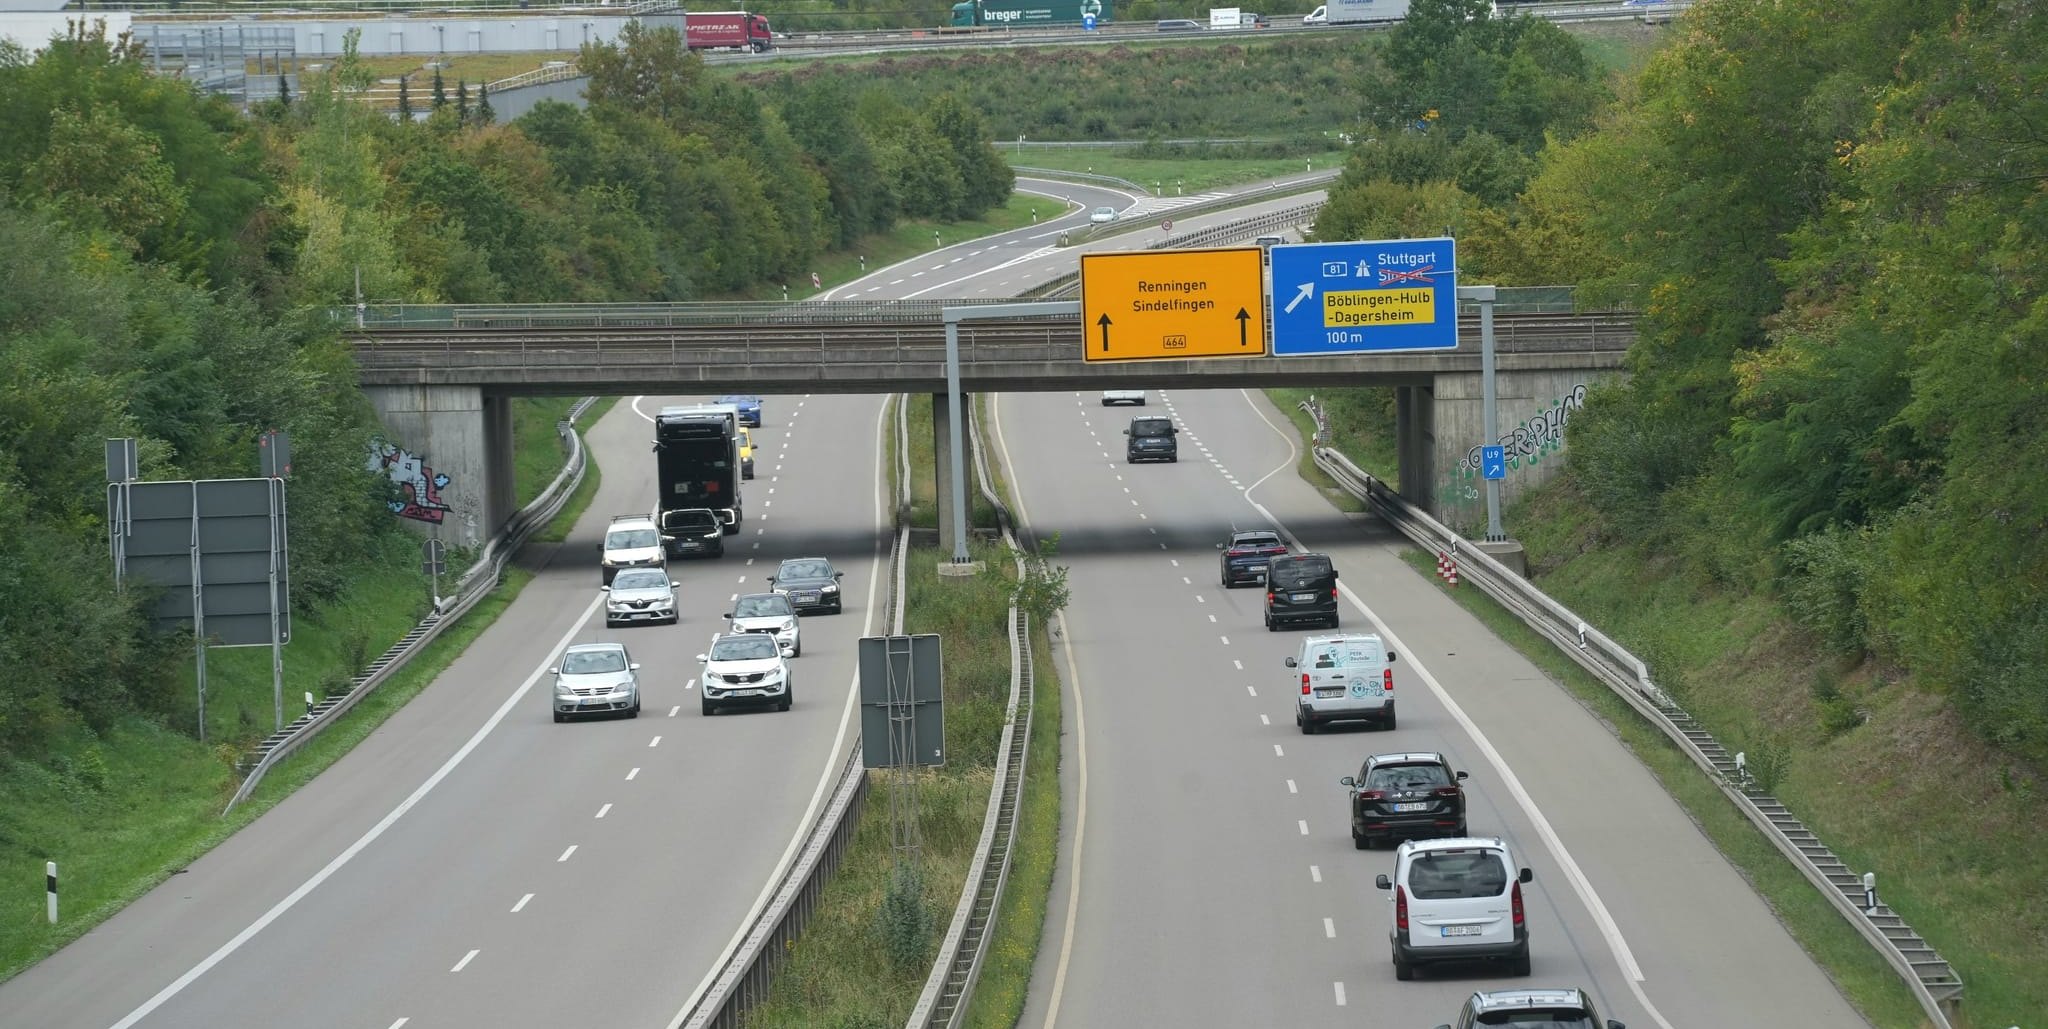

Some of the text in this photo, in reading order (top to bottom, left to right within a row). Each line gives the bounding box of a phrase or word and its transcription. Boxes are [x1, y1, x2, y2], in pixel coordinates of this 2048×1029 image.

[984, 9, 1022, 22] breger
[1378, 252, 1436, 267] Stuttgart
[1329, 265, 1341, 274] 81
[1138, 280, 1207, 294] Renningen
[1133, 298, 1215, 312] Sindelfingen
[1327, 292, 1430, 308] Böblingen-Hulb
[1328, 309, 1414, 325] -Dagersheim
[1165, 338, 1184, 347] 464
[1326, 331, 1363, 344] 100 m
